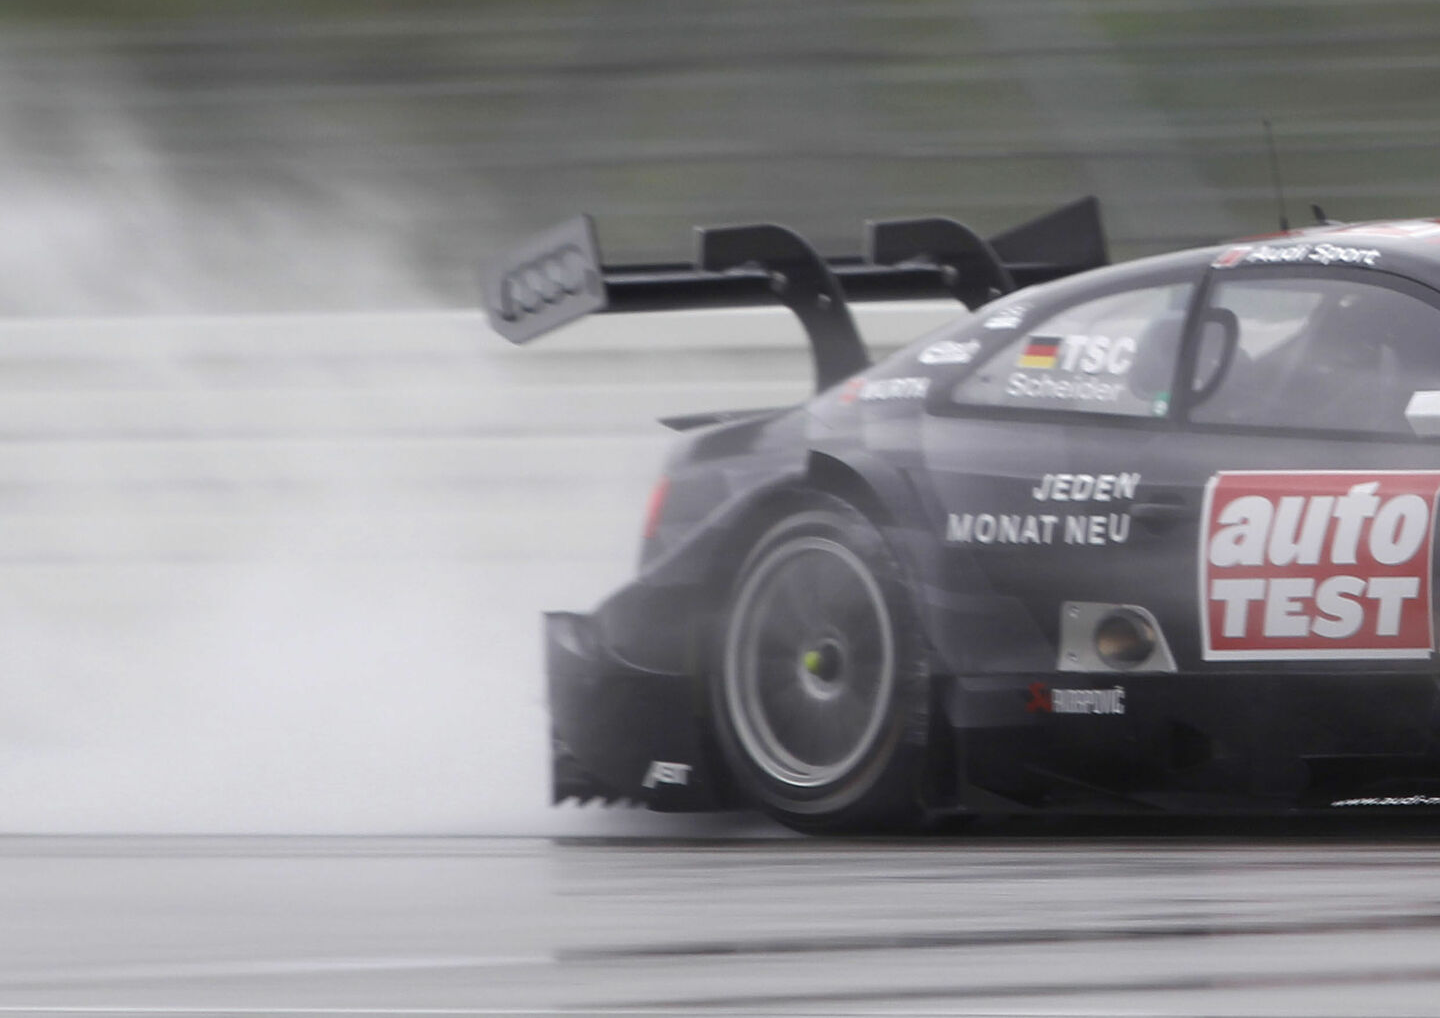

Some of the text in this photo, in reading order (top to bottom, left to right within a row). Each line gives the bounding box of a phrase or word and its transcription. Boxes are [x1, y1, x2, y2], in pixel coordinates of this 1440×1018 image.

[1247, 243, 1381, 266] Audi Sport
[1062, 334, 1138, 374] TSC
[1005, 372, 1127, 401] Scheider
[1032, 472, 1141, 501] JEDEN
[947, 513, 1131, 545] MONAT NEU
[1210, 481, 1429, 567] auto
[1210, 575, 1421, 639] TEST
